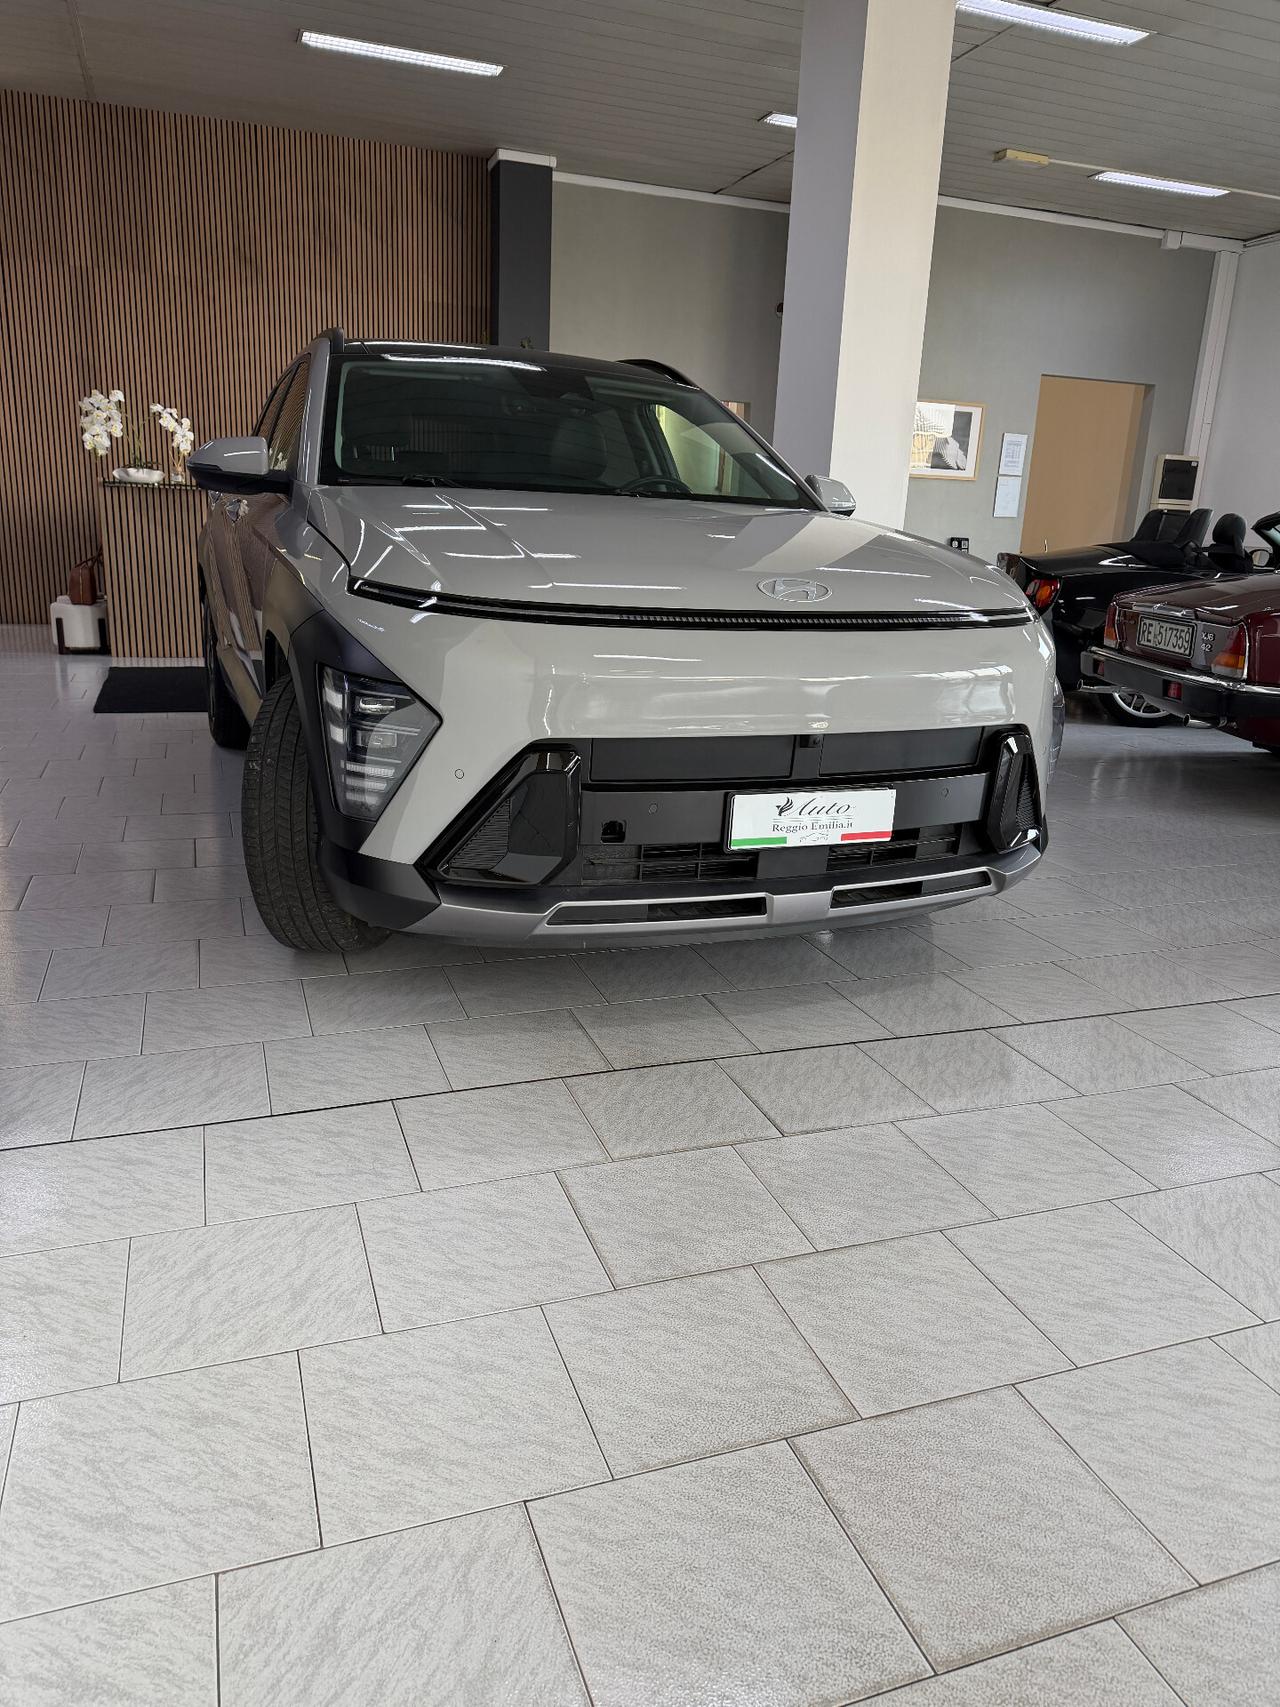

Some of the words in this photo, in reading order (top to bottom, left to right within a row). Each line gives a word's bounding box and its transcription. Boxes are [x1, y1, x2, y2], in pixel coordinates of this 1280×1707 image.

[1140, 622, 1153, 643] RE
[1158, 625, 1190, 650] 517359
[782, 797, 856, 816] Auto
[772, 822, 808, 834] Reggio
[811, 820, 853, 832] Emilia.it
